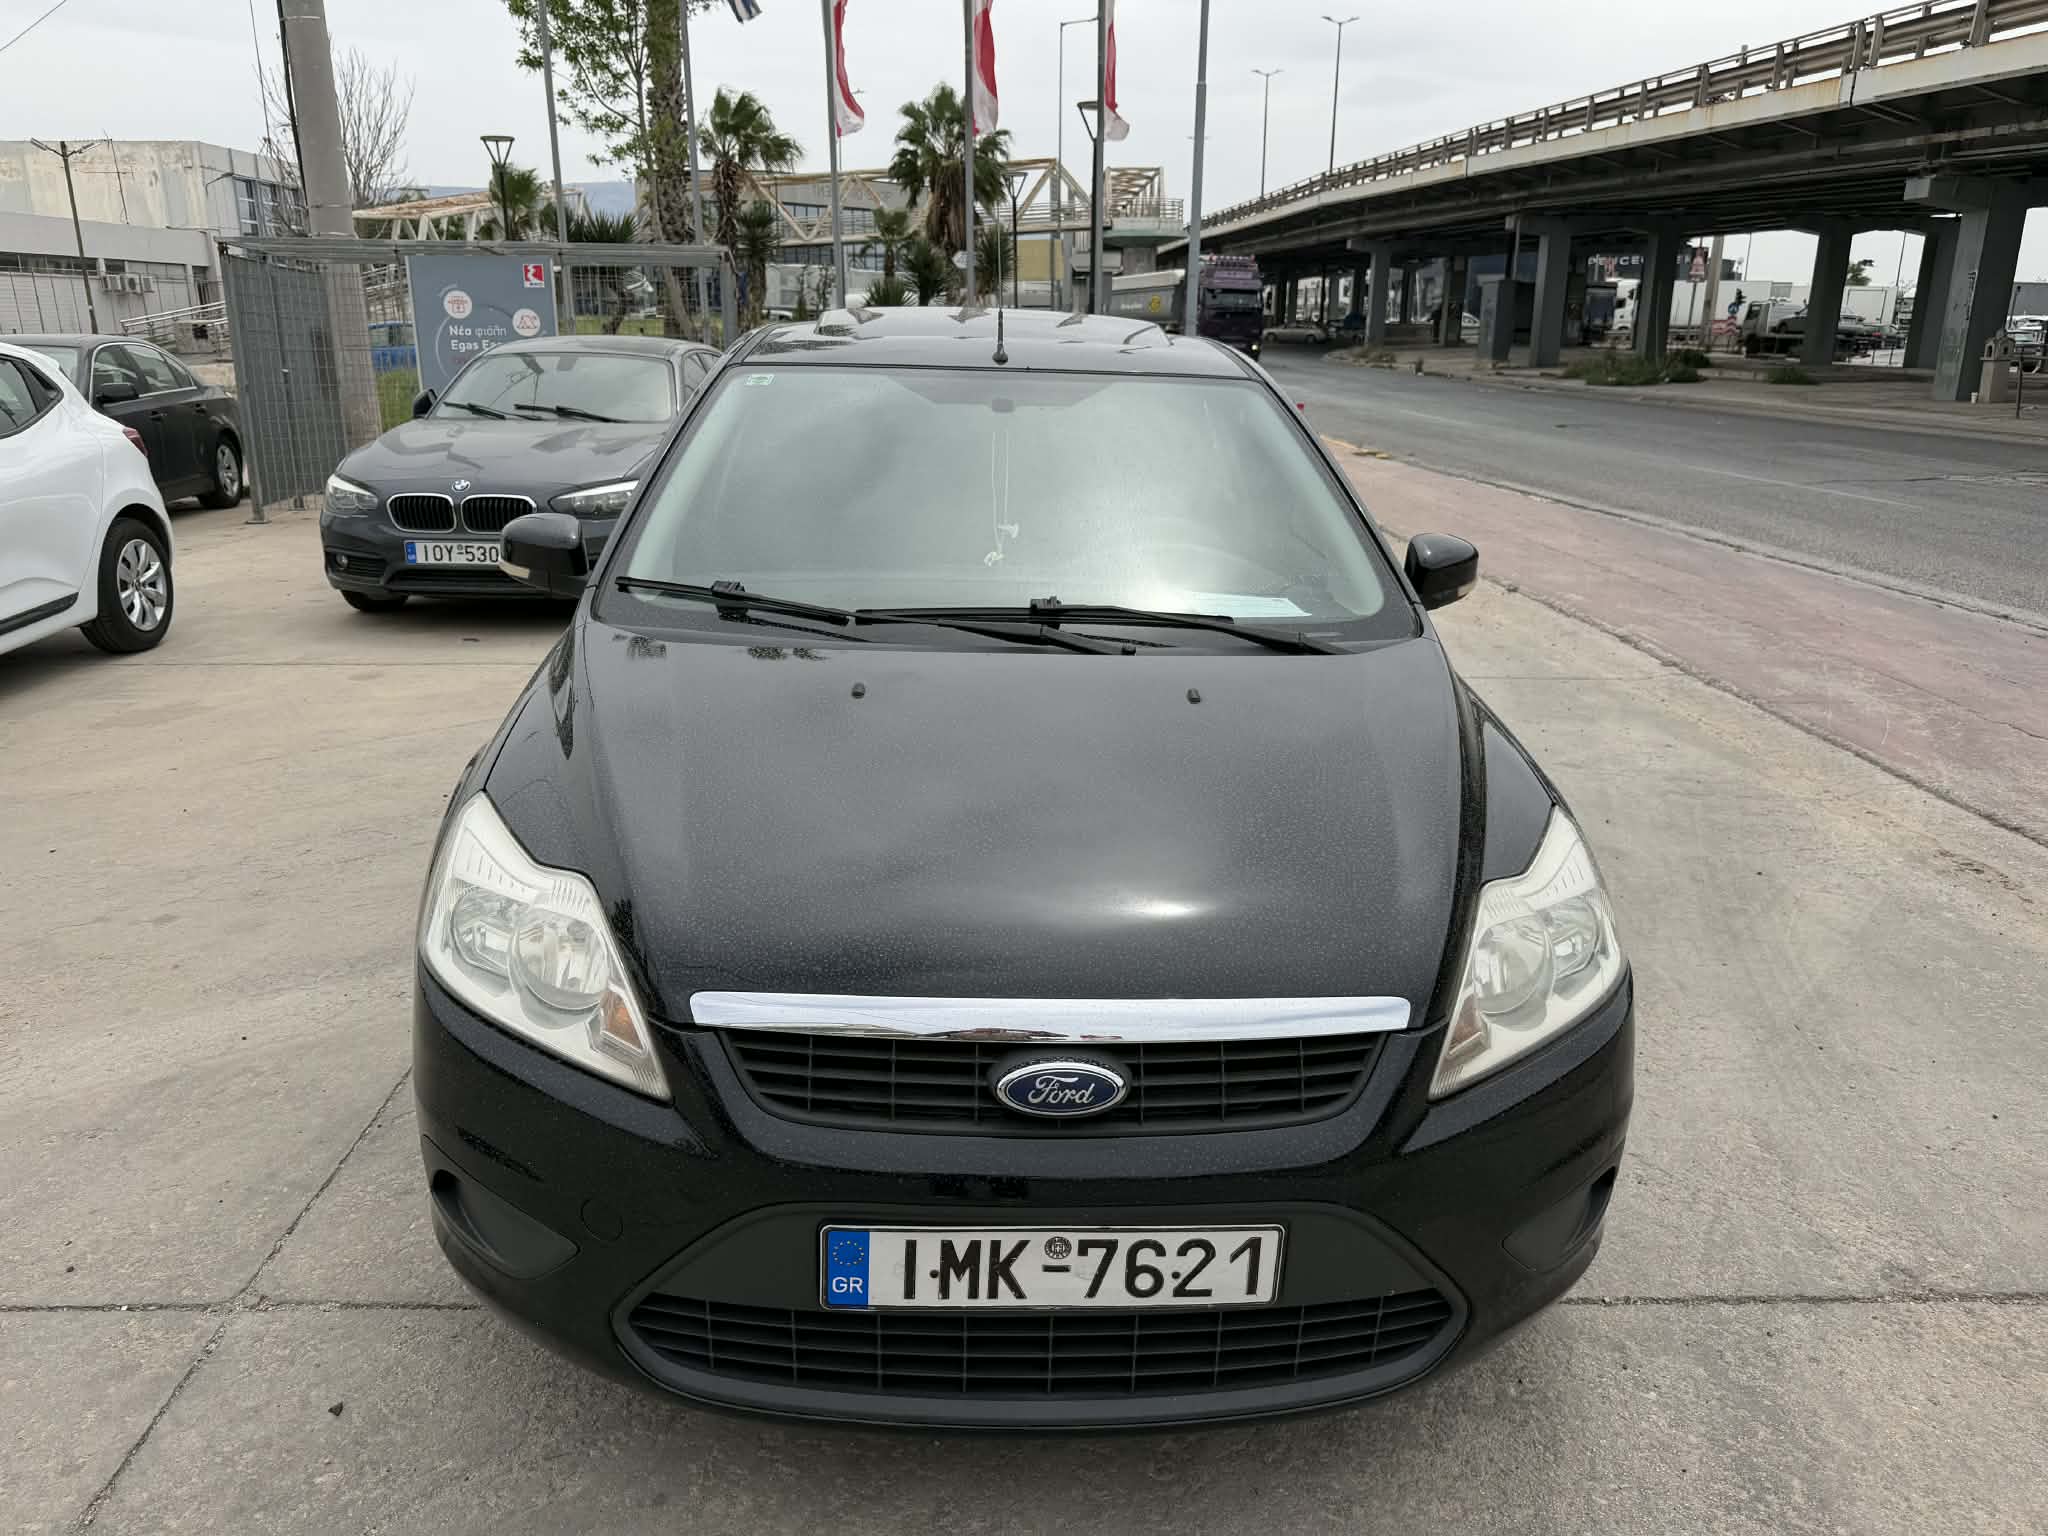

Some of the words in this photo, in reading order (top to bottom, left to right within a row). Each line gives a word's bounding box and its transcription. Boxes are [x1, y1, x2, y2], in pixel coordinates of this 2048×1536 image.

[450, 339, 480, 353] Egas
[423, 543, 499, 563] IOY-530
[1028, 1075, 1096, 1104] Ford
[832, 1276, 864, 1294] GR
